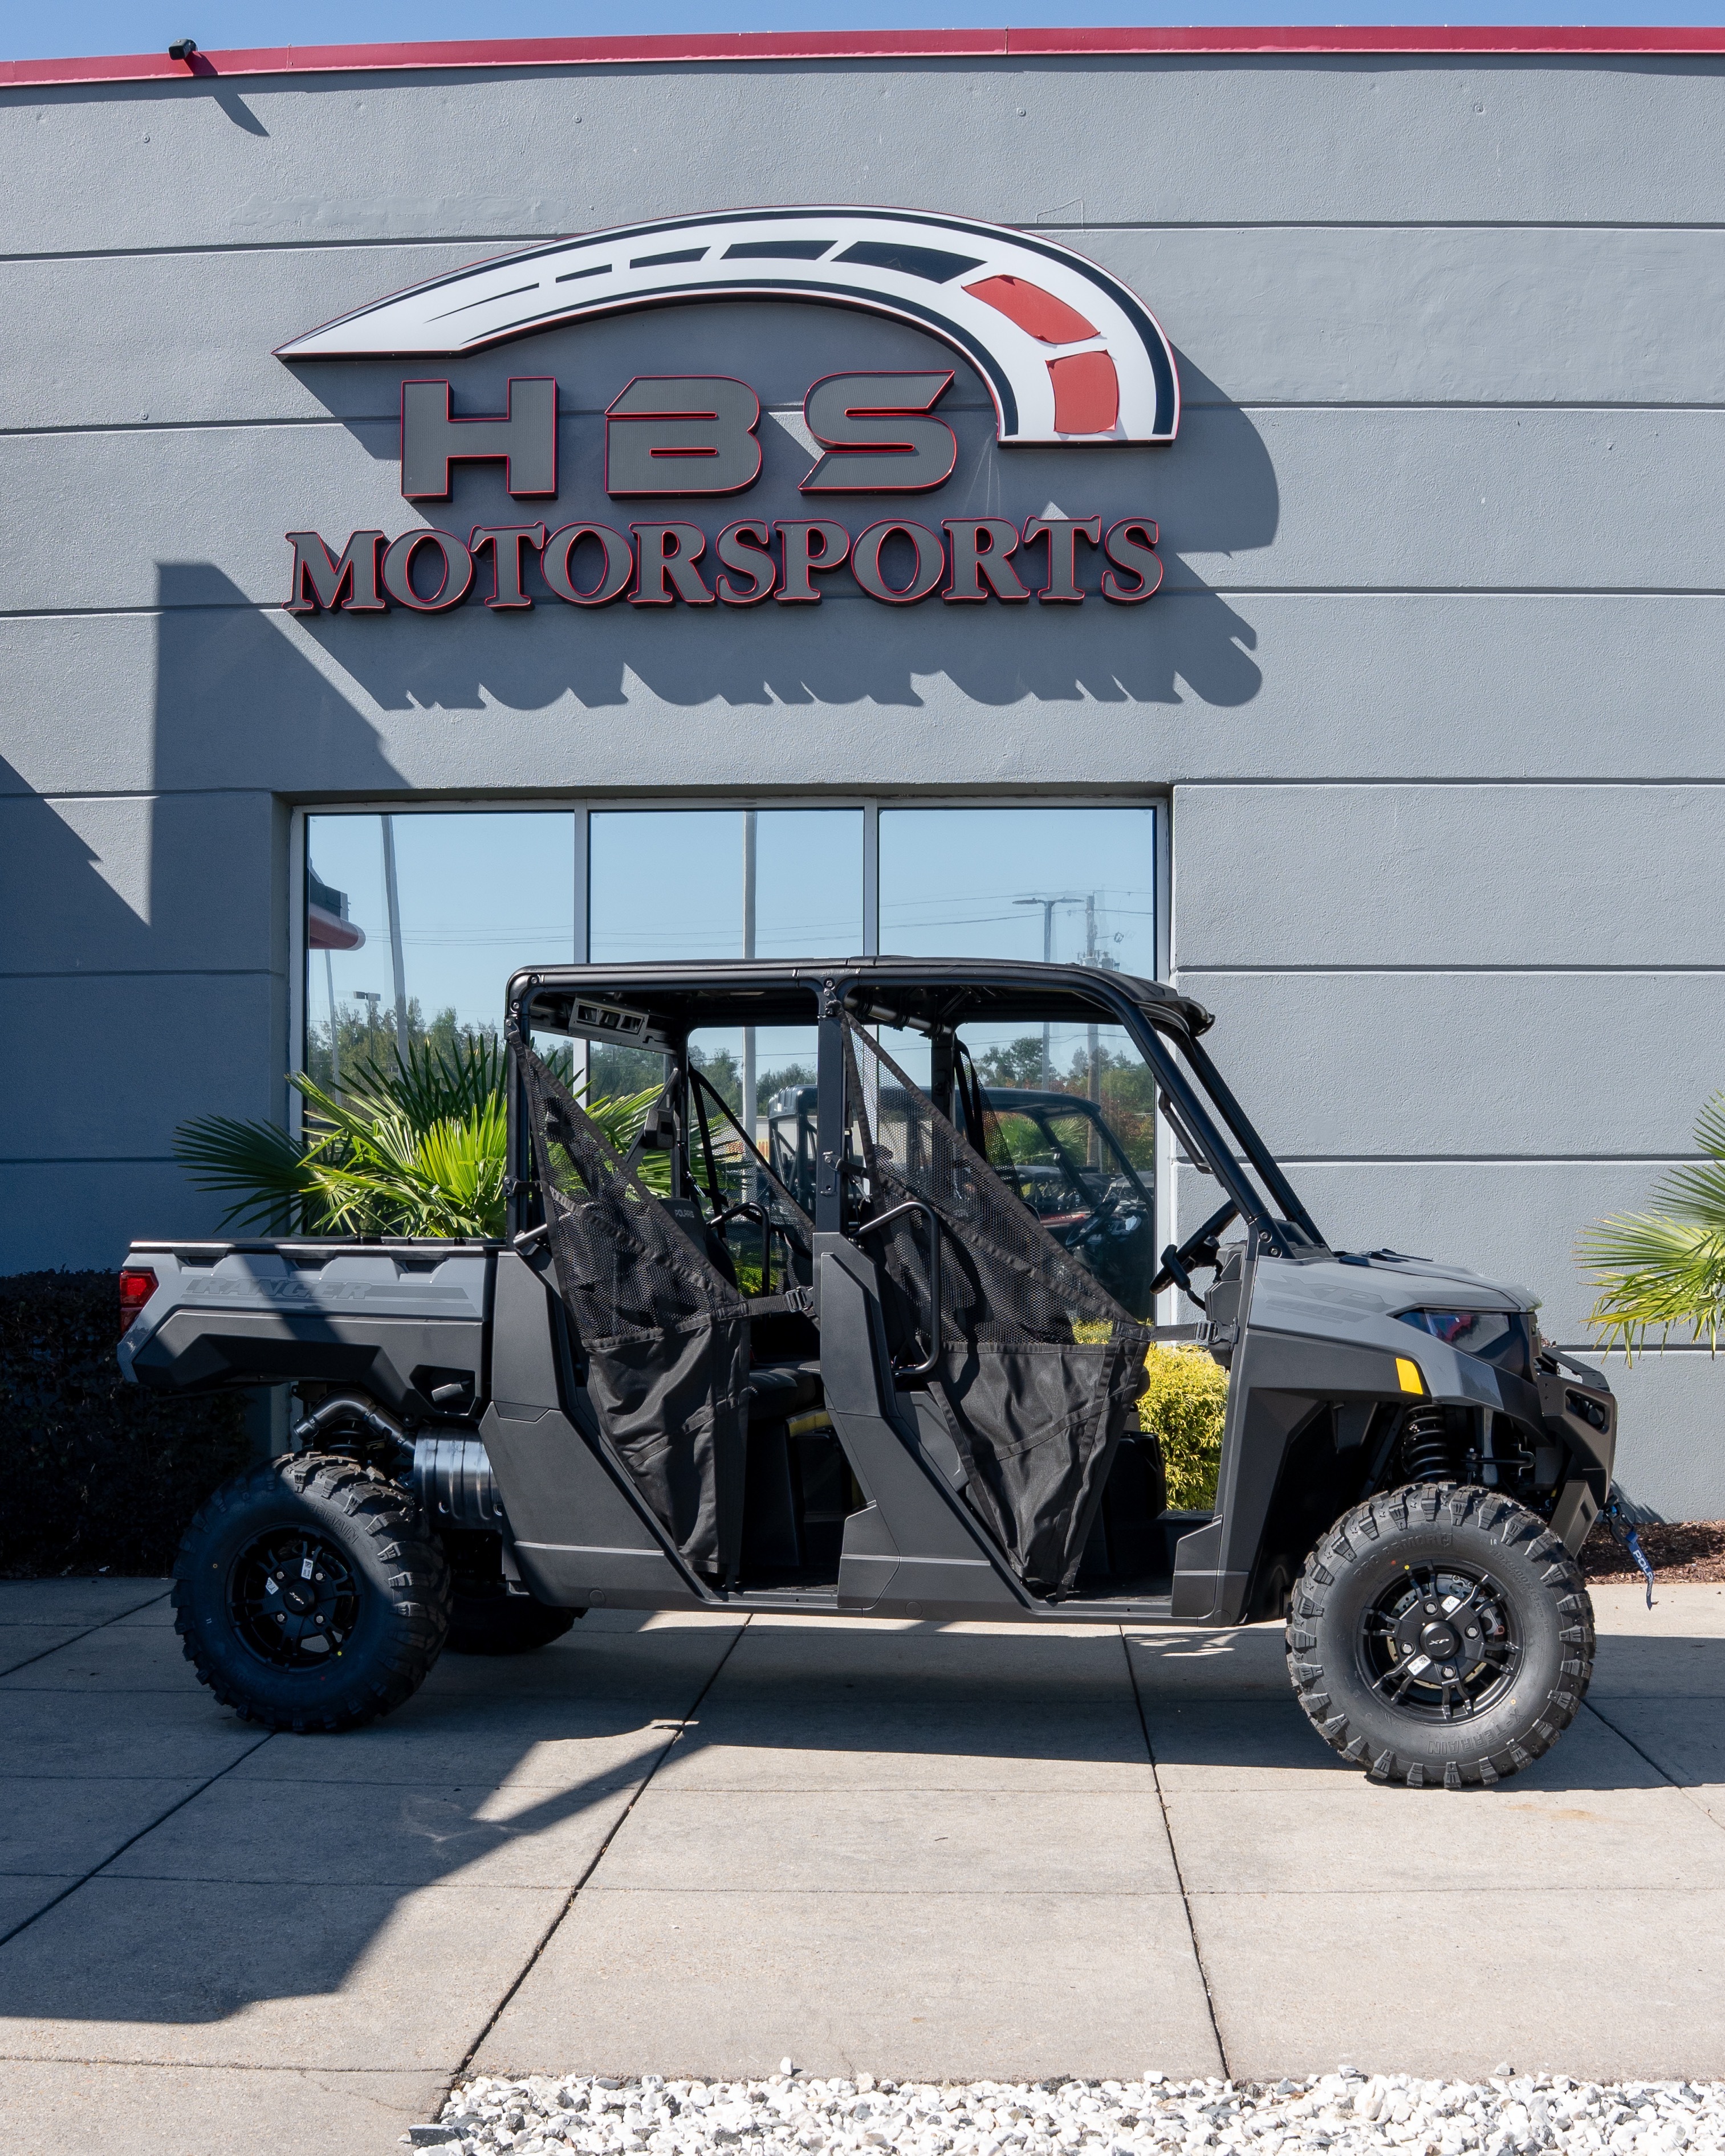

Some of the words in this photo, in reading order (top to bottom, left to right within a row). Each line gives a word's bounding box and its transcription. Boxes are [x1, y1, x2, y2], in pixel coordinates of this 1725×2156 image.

[401, 370, 958, 500] HBS
[284, 514, 1163, 614] MOTORSPORTS
[193, 1276, 373, 1300] RANGER
[1427, 1708, 1525, 1755] X-TERRAIN
